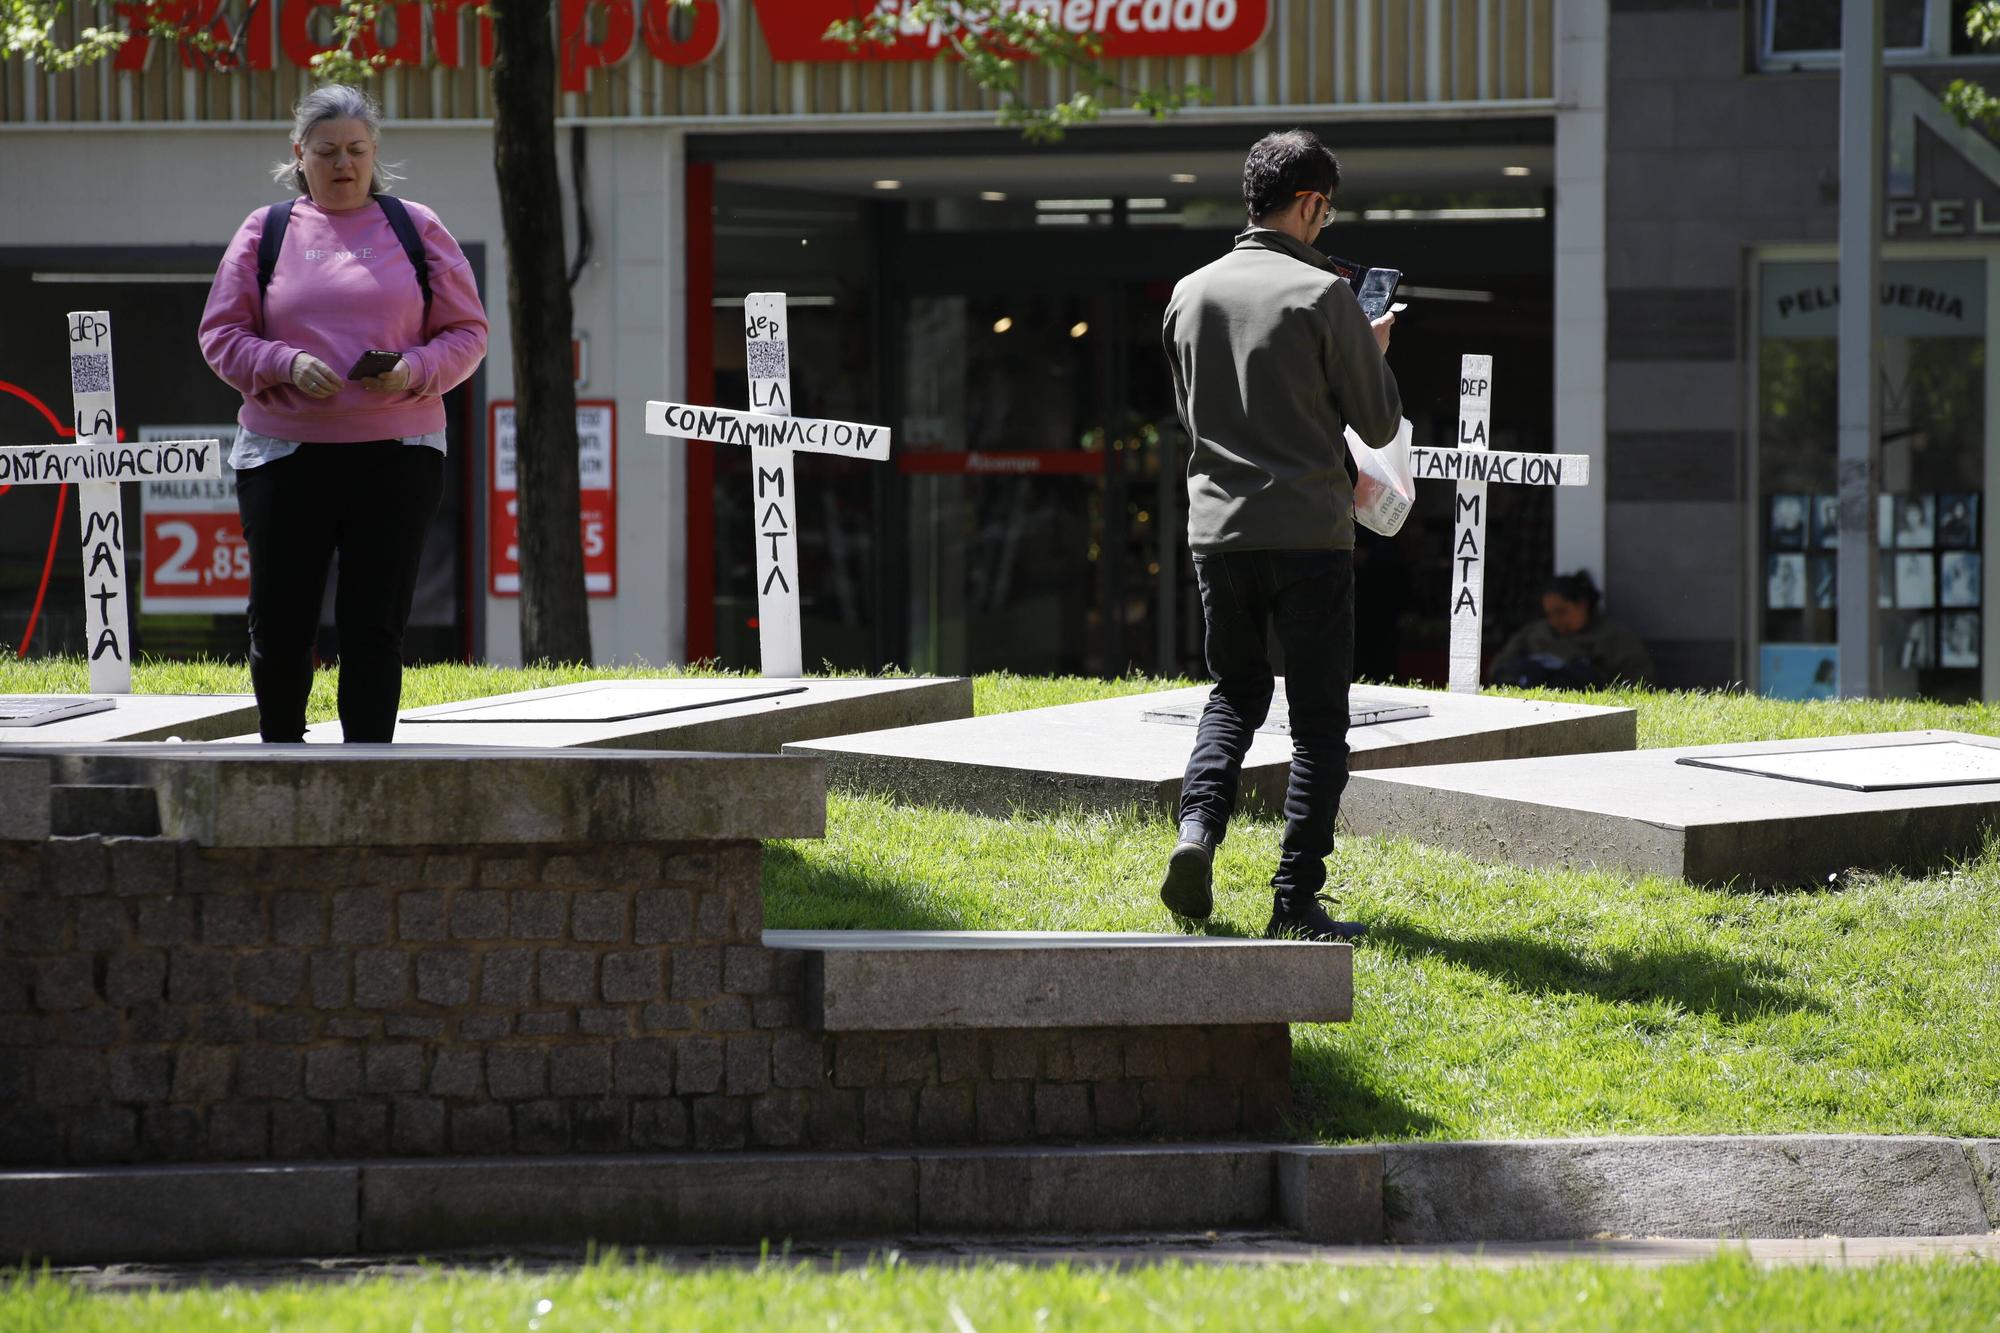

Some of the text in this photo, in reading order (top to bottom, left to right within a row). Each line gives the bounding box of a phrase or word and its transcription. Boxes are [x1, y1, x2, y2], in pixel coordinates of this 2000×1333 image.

[751, 380, 786, 408] LA
[1461, 378, 1488, 397] DEP
[77, 408, 113, 438] LA
[664, 405, 878, 451] CONTAMINACION
[1460, 419, 1486, 446] LA
[758, 466, 790, 596] MATA
[1454, 493, 1480, 617] MATA
[83, 511, 121, 661] MATA
